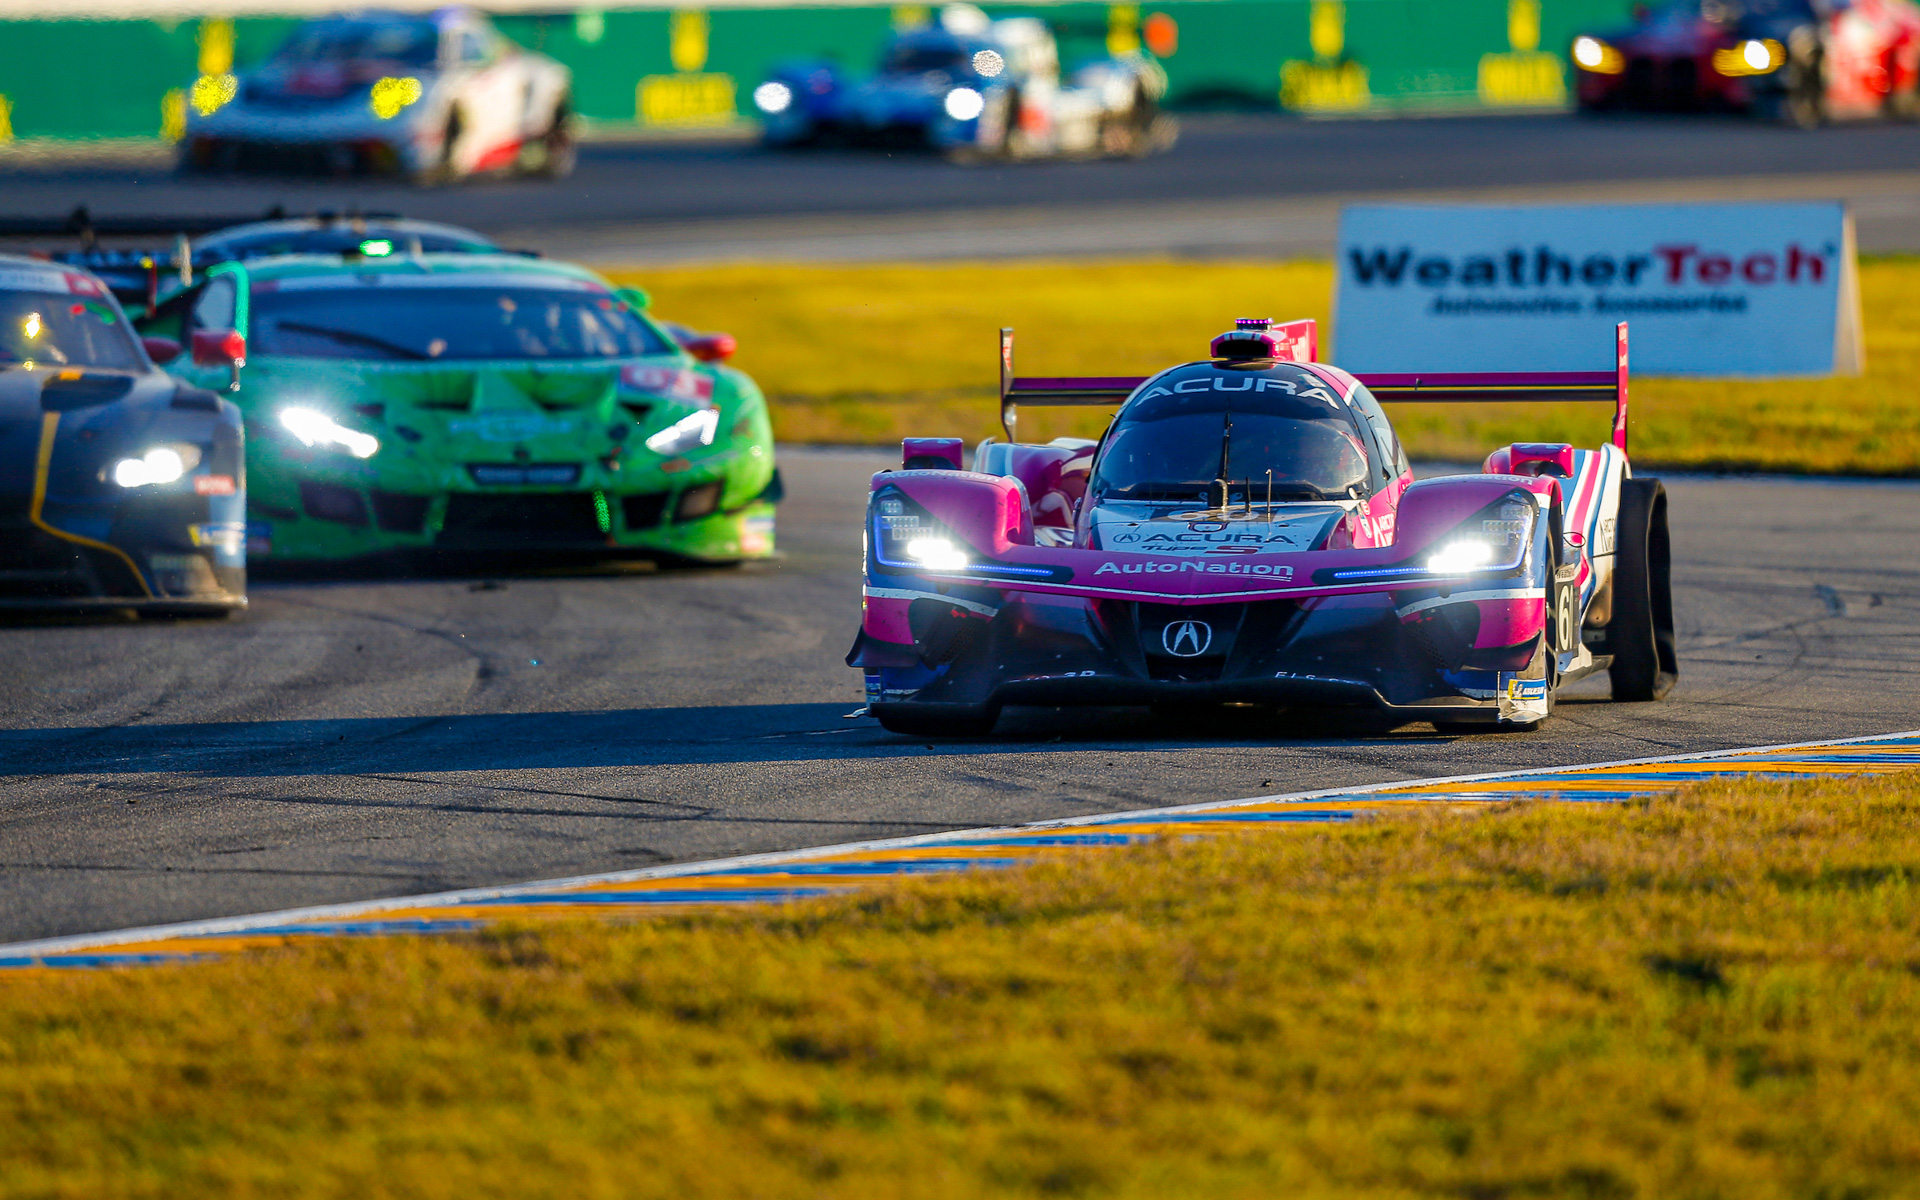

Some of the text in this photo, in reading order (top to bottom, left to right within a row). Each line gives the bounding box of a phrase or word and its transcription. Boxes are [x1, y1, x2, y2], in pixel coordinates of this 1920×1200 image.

[1349, 243, 1826, 287] WeatherTech
[1135, 377, 1340, 410] ACURA
[1143, 533, 1298, 545] ACURA
[1094, 560, 1295, 576] AutoNation
